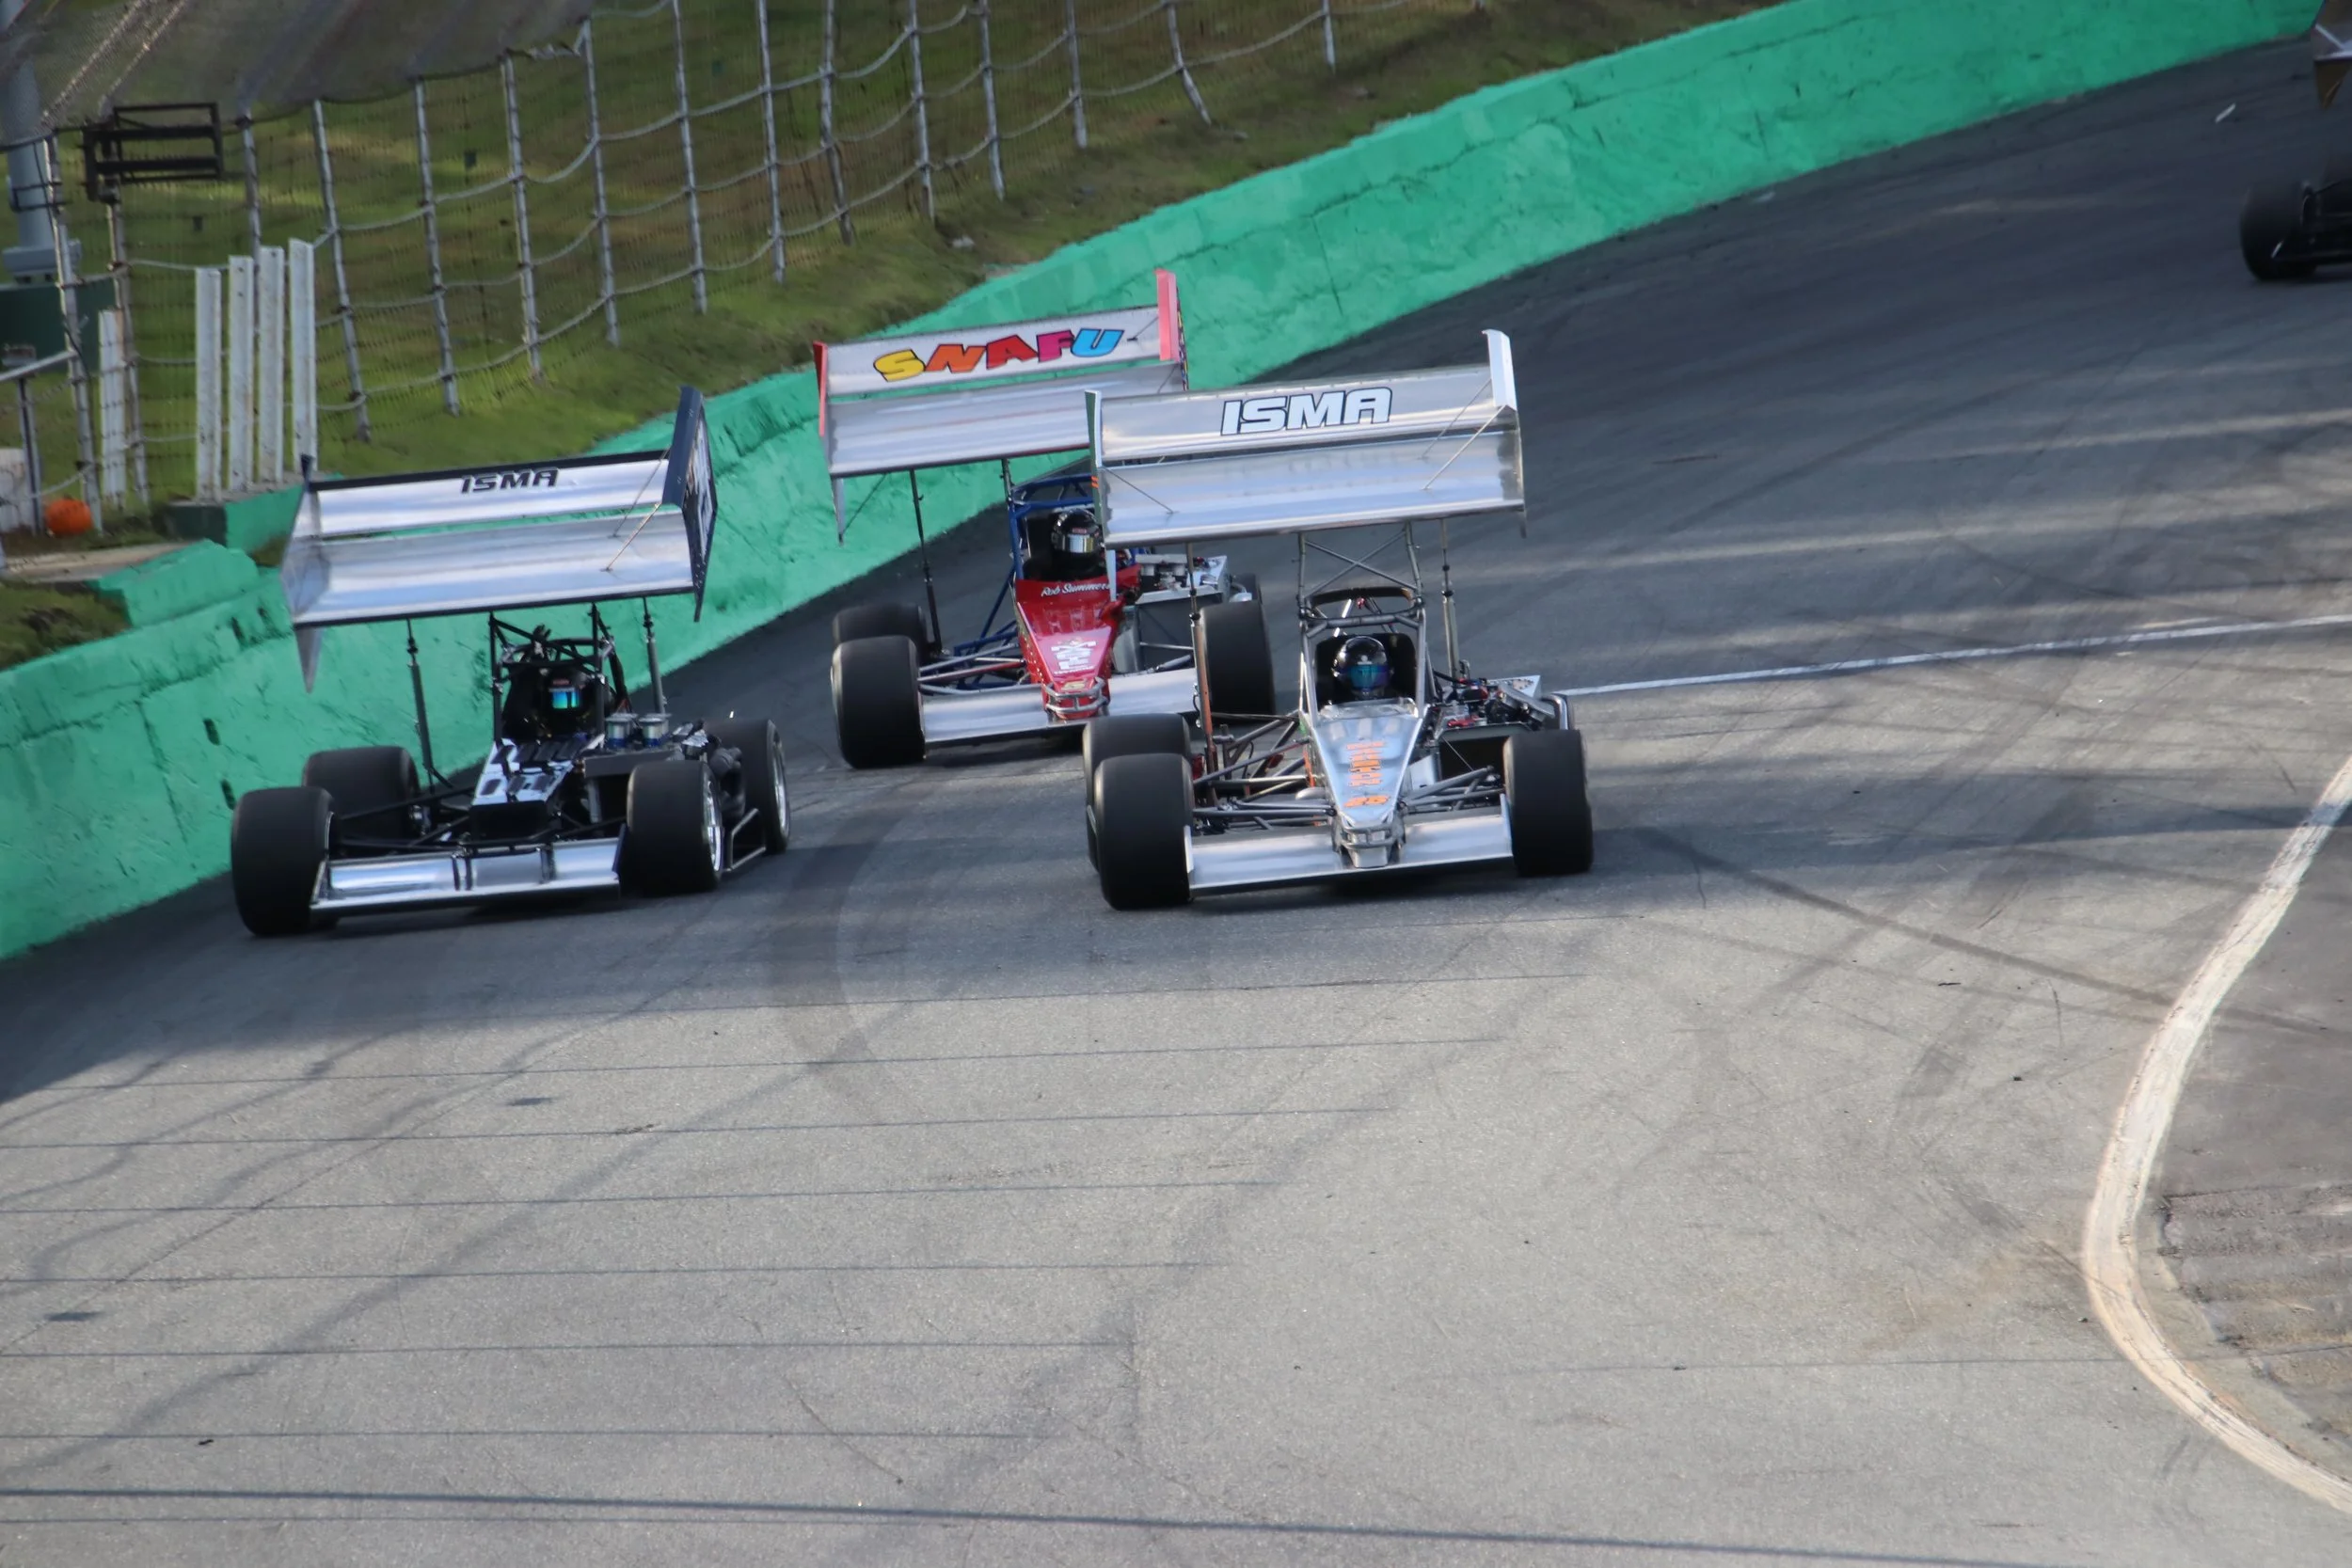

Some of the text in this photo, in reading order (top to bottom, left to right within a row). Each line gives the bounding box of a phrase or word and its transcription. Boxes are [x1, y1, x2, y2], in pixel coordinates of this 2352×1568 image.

[873, 327, 1124, 382] SNAFU
[1220, 387, 1392, 436] ISMA
[461, 467, 559, 494] ISMA
[1041, 585, 1060, 597] Rob
